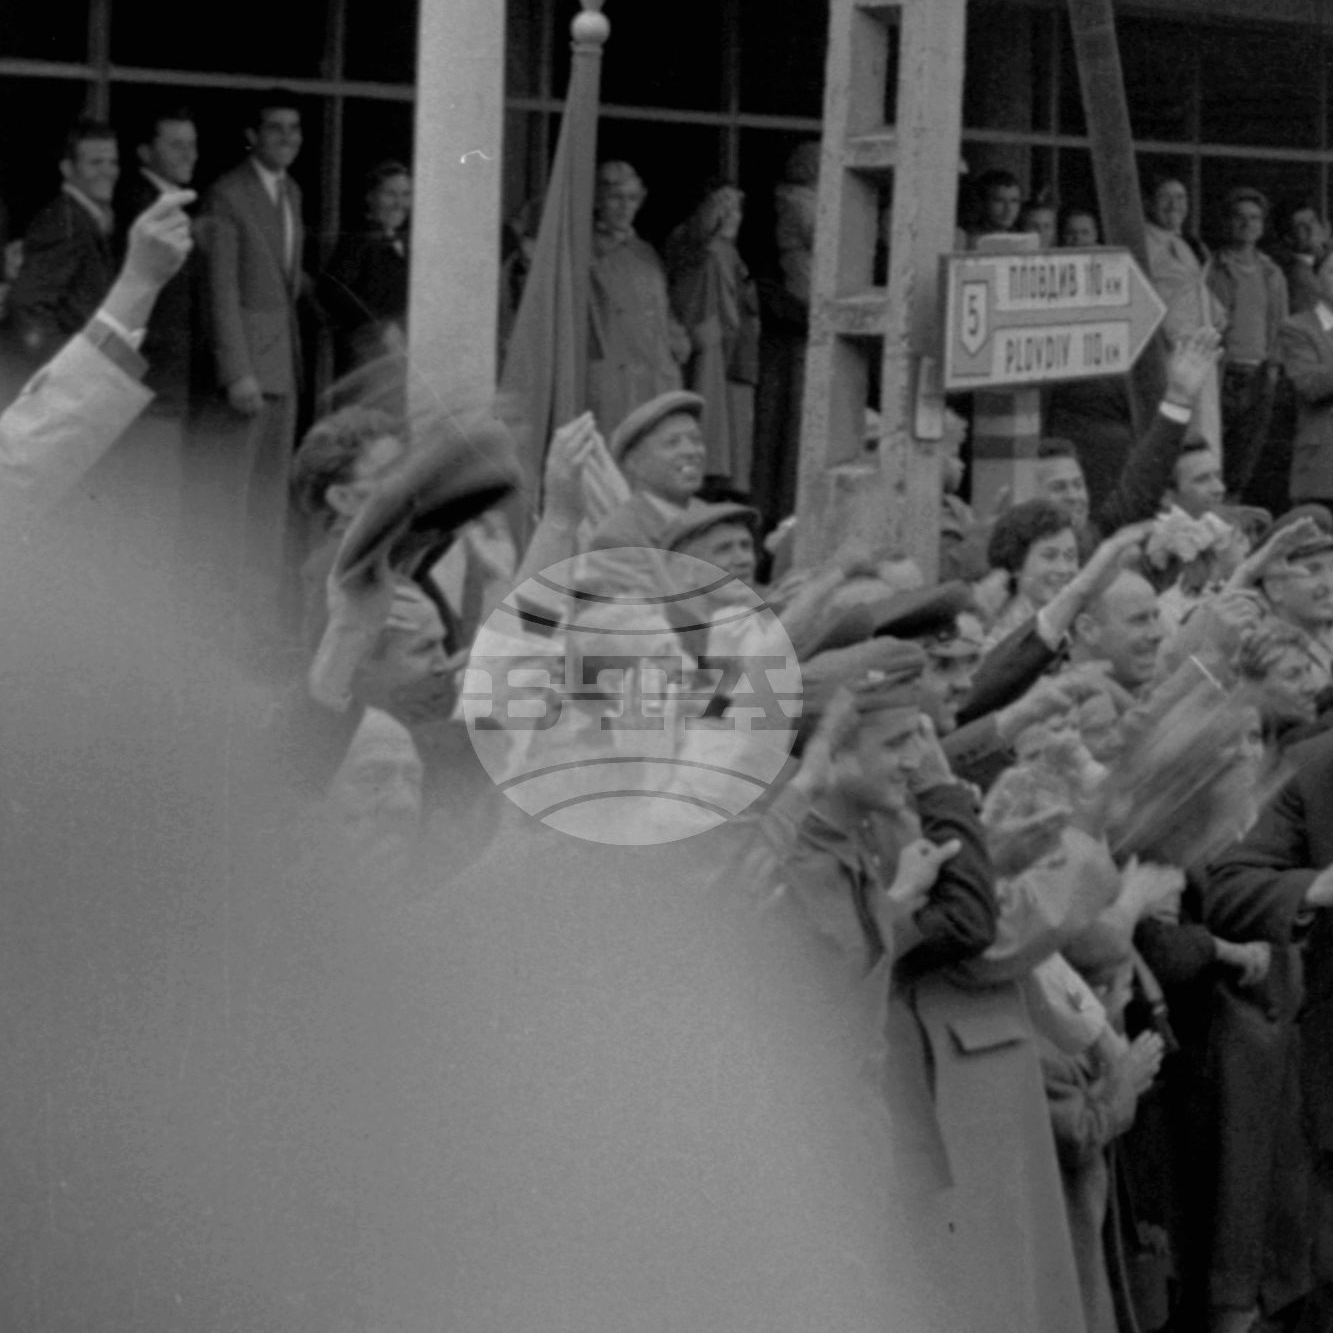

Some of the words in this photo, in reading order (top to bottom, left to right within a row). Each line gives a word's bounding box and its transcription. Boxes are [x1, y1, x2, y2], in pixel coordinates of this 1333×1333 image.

[1008, 263, 1077, 302] ПЛОВДИВ
[967, 293, 980, 337] 5
[1005, 333, 1071, 375] PLOVDIV
[1083, 332, 1102, 367] 110
